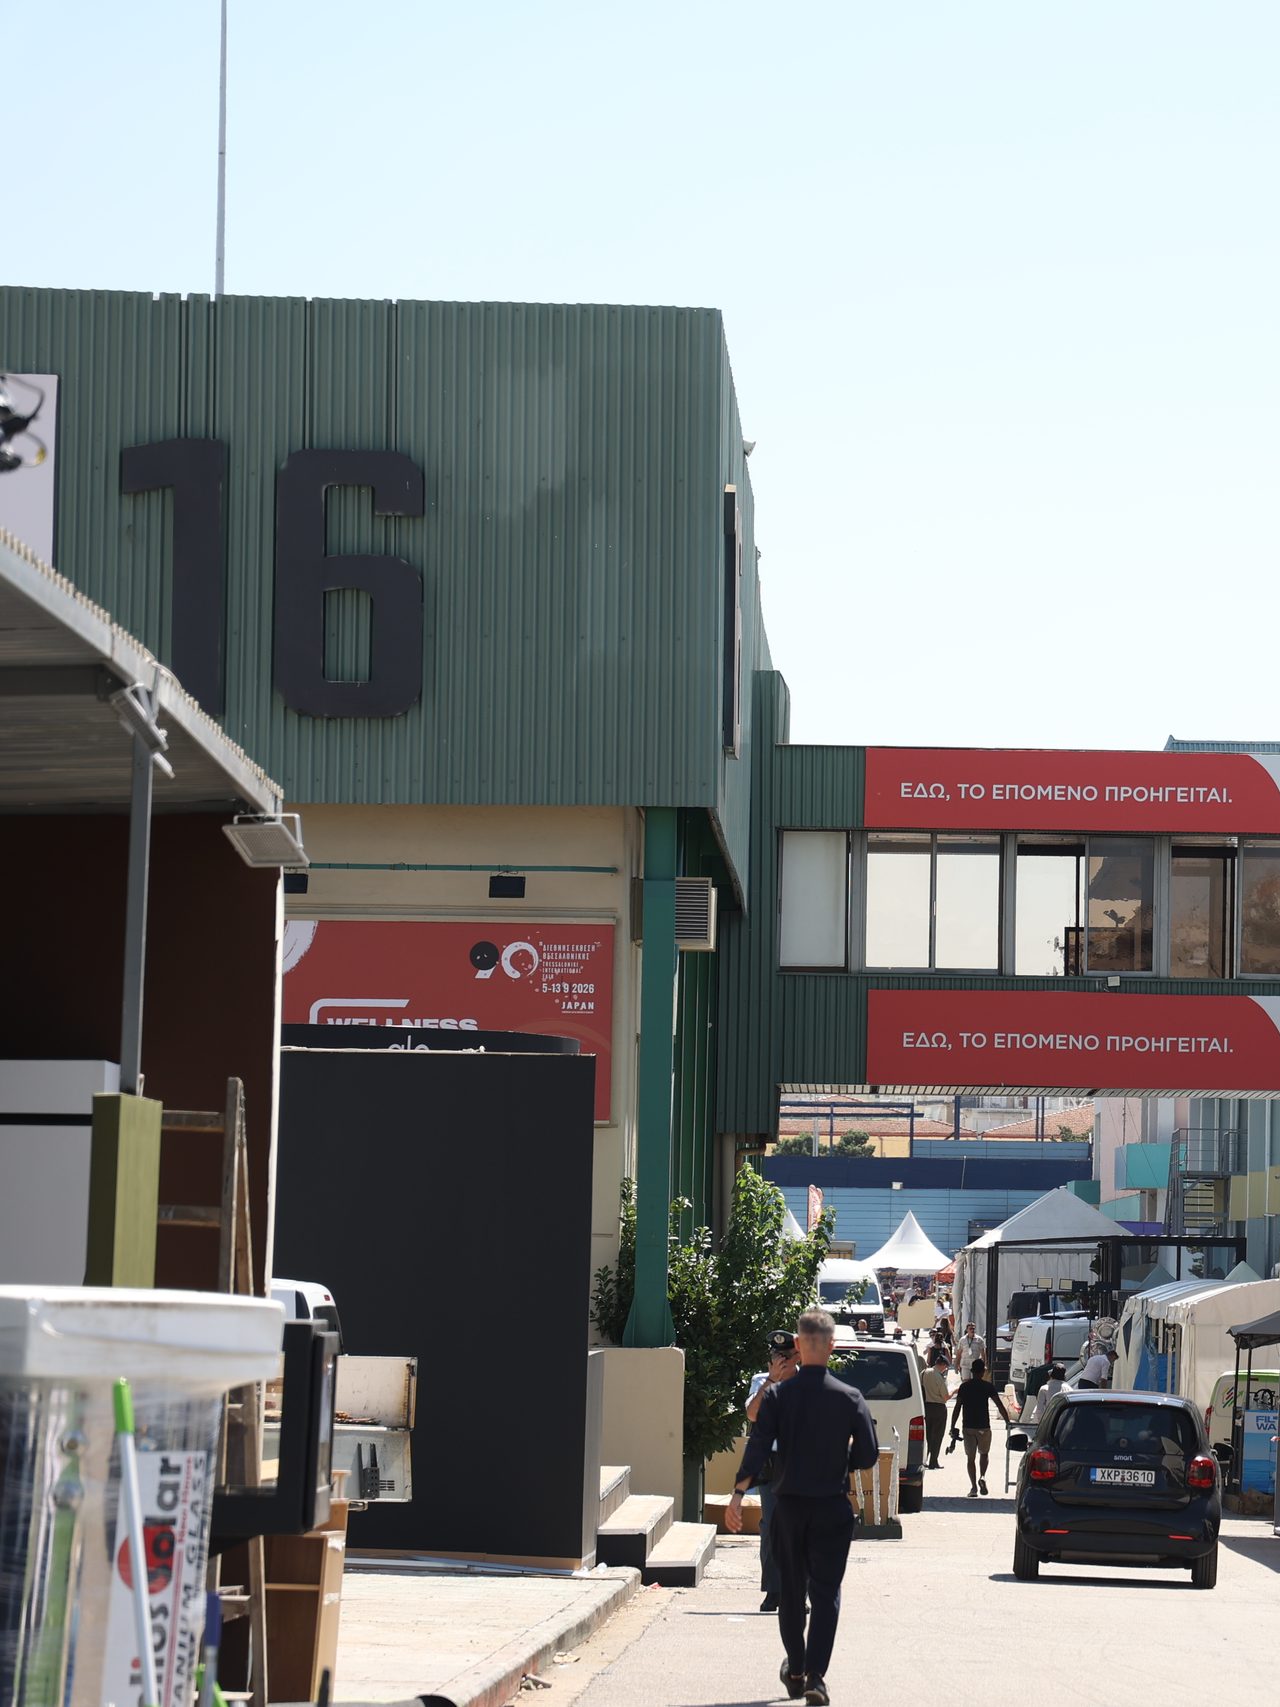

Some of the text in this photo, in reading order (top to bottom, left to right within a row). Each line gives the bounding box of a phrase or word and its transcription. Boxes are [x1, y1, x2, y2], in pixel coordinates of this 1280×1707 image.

[121, 437, 424, 719] 16
[900, 782, 1233, 804] ΕΔΩ, ΤΟ ΕΠΟΜΕΝΟ ΠΡΟΗΓΕΙΤΑΙ.
[543, 952, 590, 960] ΘΕΣΣΑΛΟΝΙΚΗΣ
[561, 1001, 594, 1010] JAPAN
[903, 1032, 1234, 1053] ΕΔΩ, ΤΟ ΕΠΟΜΕΝΟ ΠΡΟΗΓΕΙΤΑΙ.
[1126, 1470, 1154, 1483] 3610
